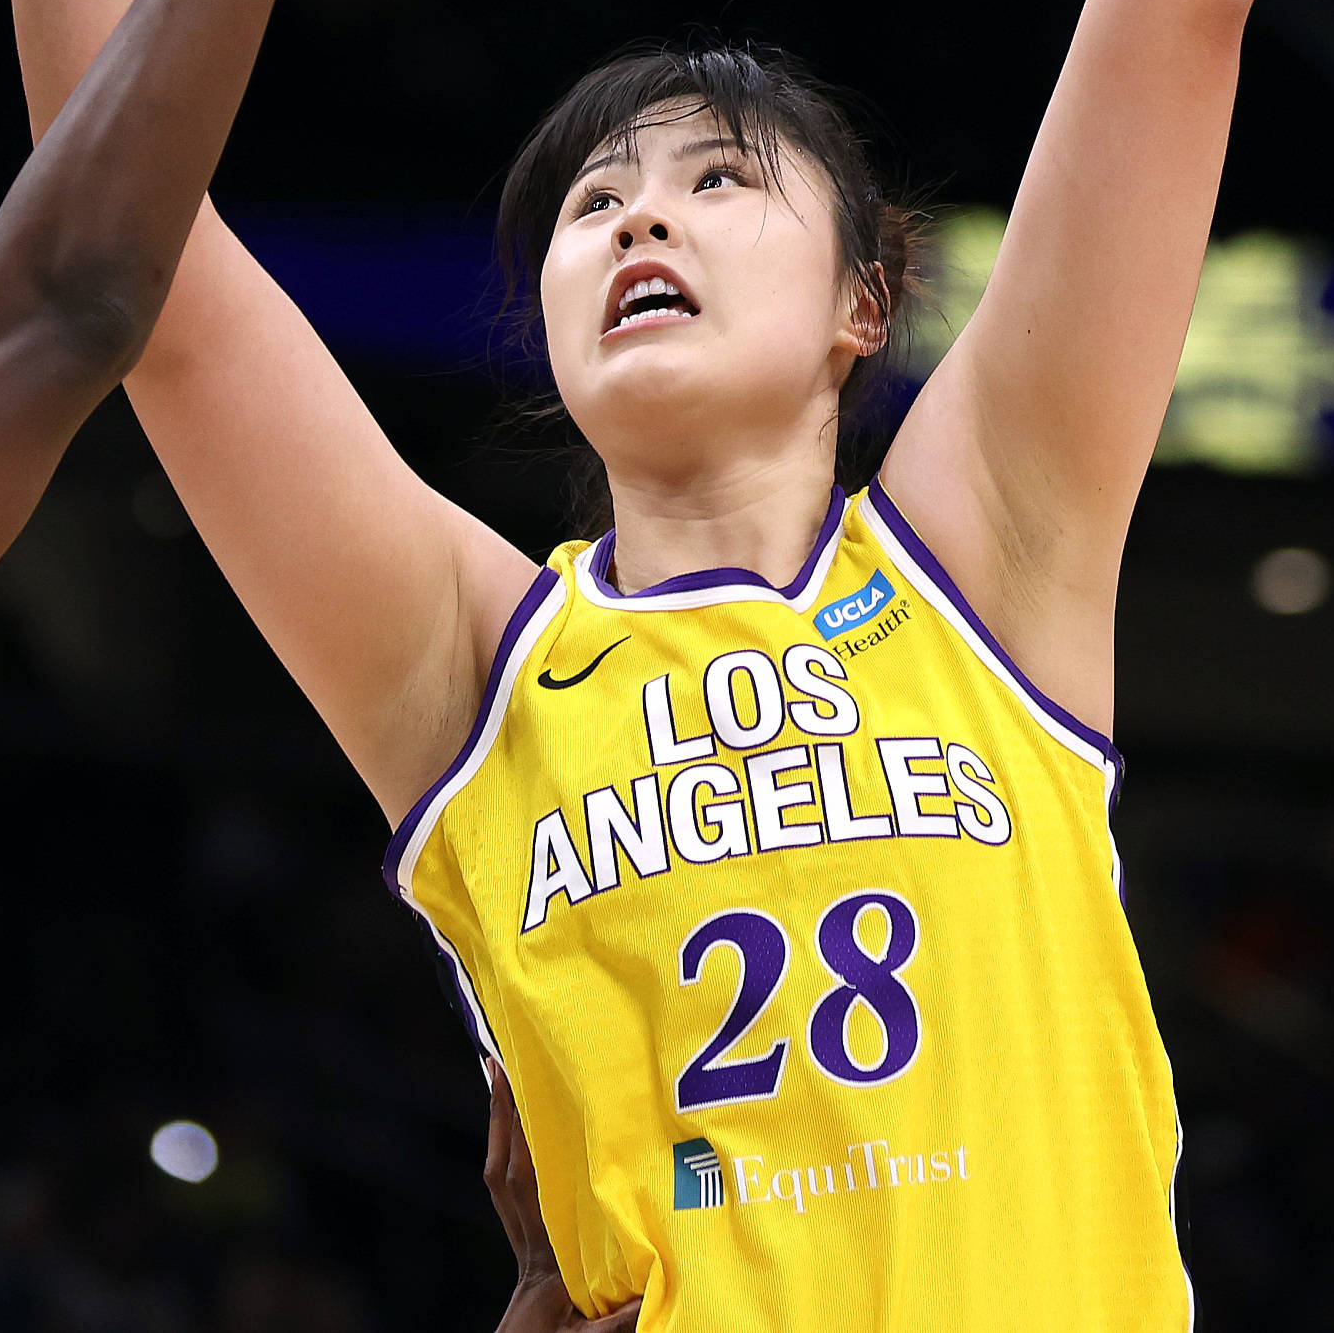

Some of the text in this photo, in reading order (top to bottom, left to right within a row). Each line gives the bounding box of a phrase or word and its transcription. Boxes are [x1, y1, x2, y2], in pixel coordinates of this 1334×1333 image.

[823, 586, 885, 628] UCLA
[643, 643, 860, 767] LOS
[521, 737, 1012, 935] ANGELES
[674, 888, 923, 1115] 28
[731, 1139, 972, 1214] EquiTrust
